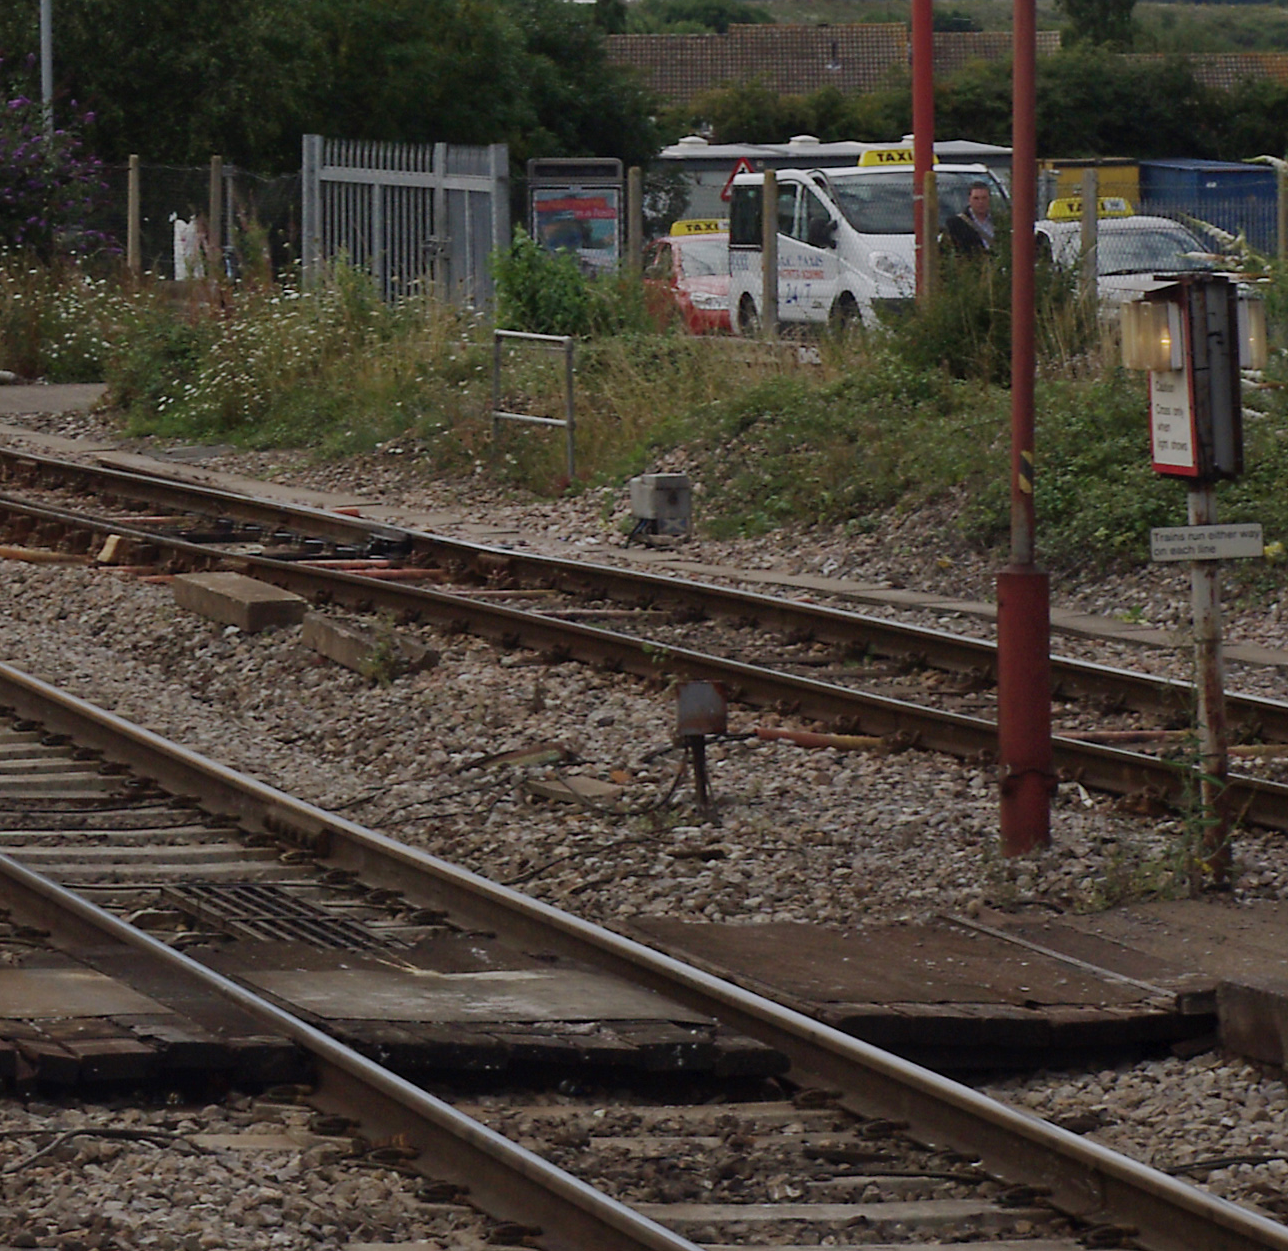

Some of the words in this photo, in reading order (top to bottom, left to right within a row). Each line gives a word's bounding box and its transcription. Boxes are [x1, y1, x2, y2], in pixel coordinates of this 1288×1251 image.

[876, 152, 914, 163] TAXI
[1067, 203, 1106, 213] TAI
[685, 223, 718, 233] TAXI
[1155, 380, 1174, 393] Caution
[1155, 403, 1171, 416] Cross
[1173, 406, 1184, 420] only
[1156, 421, 1171, 433] when
[1157, 438, 1169, 452] light
[1171, 439, 1188, 451] shows
[1154, 531, 1186, 543] Trains
[1187, 532, 1206, 541] run
[1207, 529, 1238, 540] either
[1239, 529, 1261, 541] way
[1154, 547, 1167, 557] on
[1169, 544, 1196, 556] each
[1197, 543, 1216, 554] line
